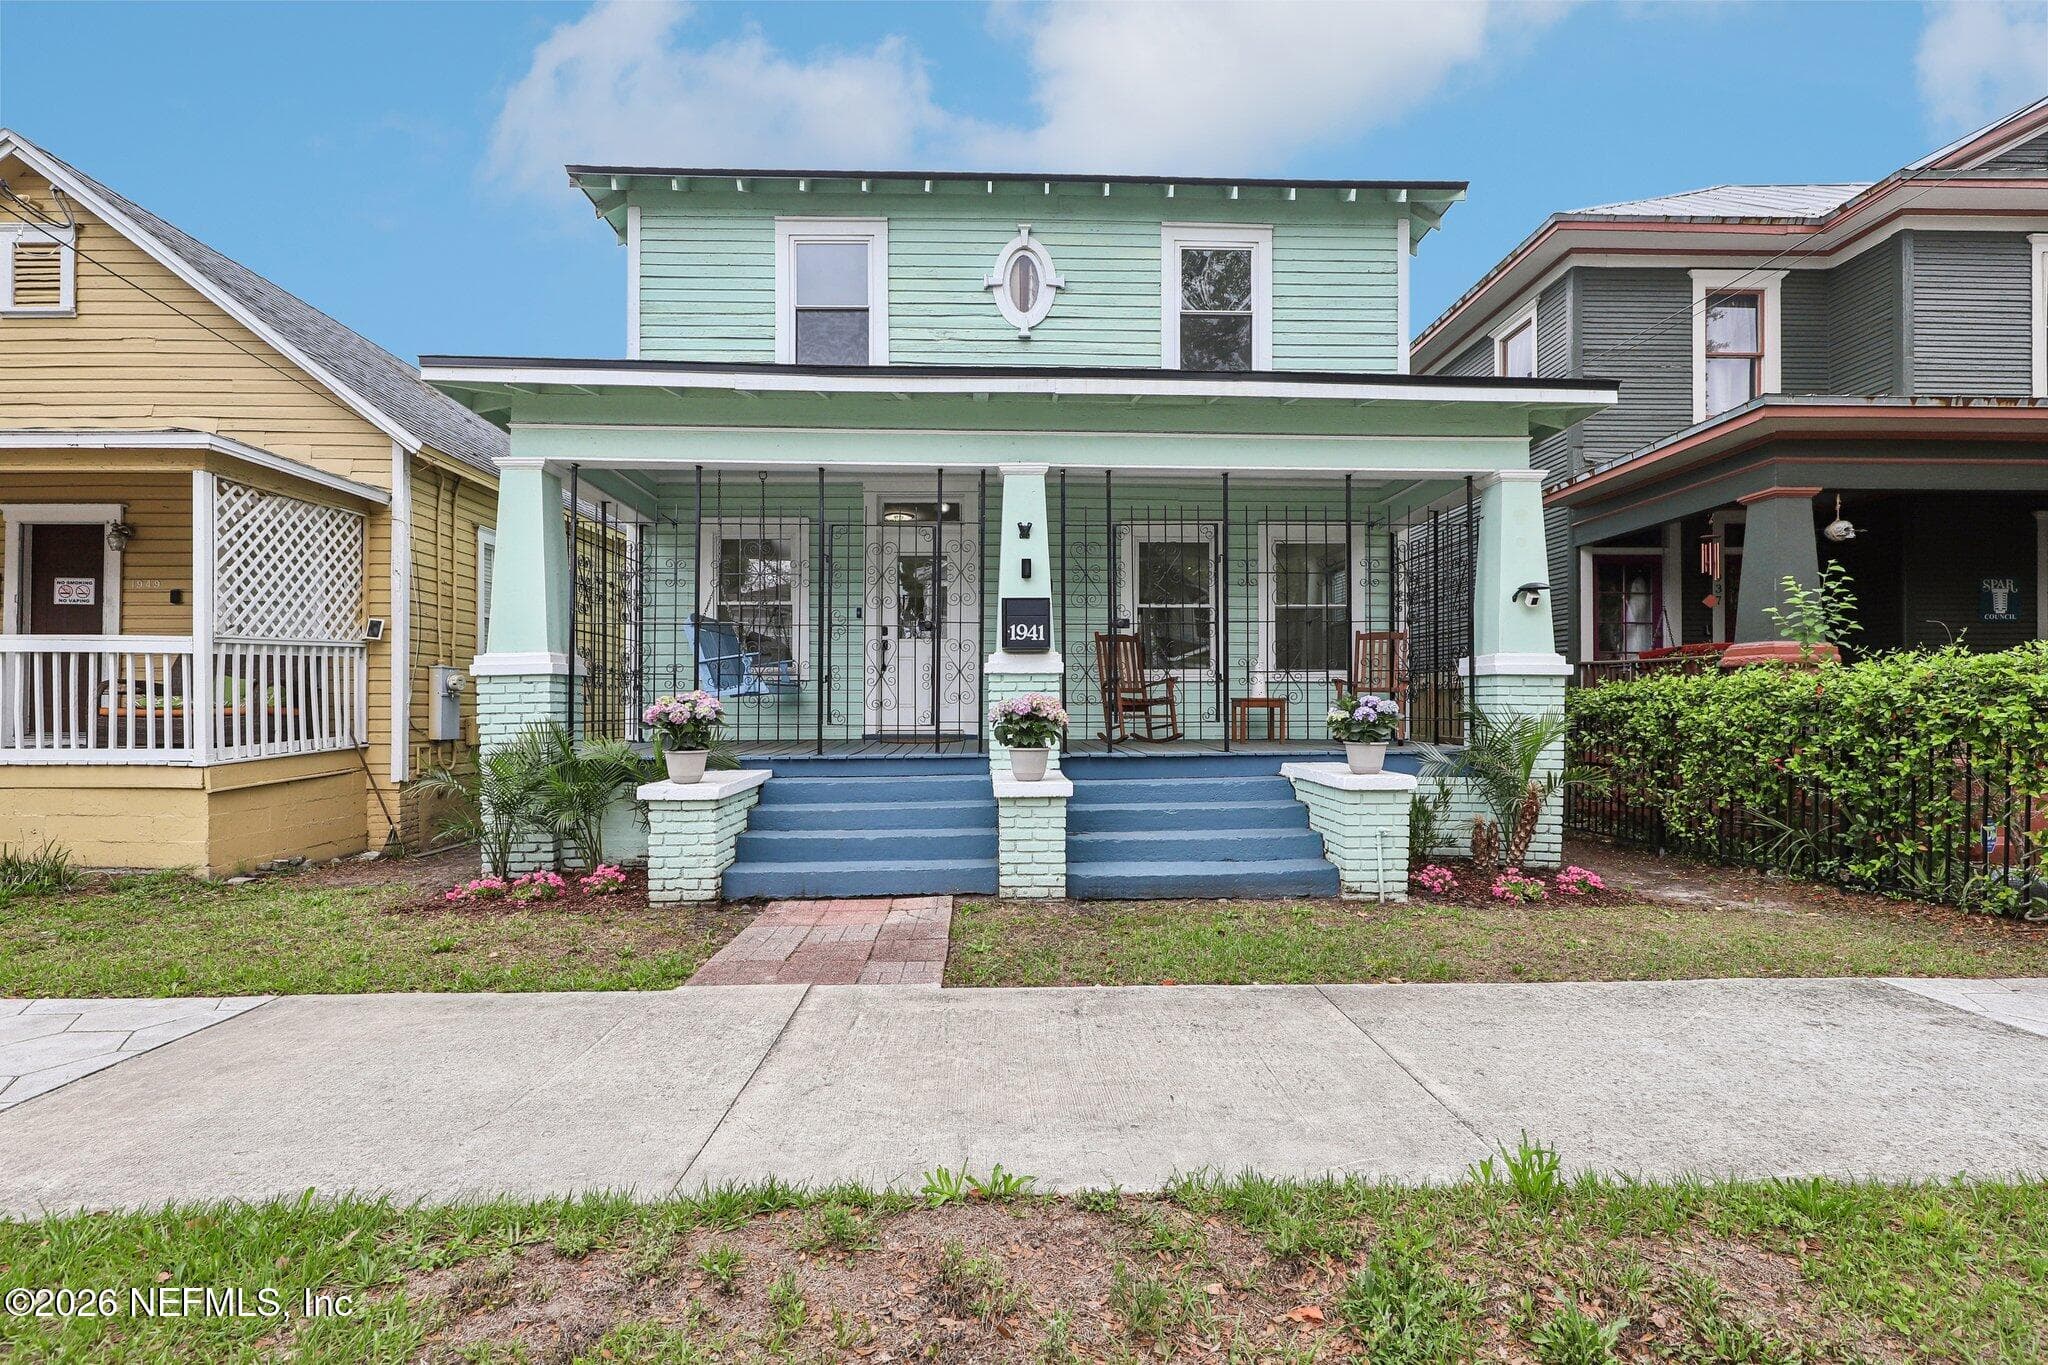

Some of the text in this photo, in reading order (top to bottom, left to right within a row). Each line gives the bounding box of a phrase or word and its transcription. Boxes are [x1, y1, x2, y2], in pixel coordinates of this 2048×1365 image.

[131, 579, 160, 589] 1949
[1982, 579, 2018, 593] SPAR
[1009, 623, 1045, 641] 1941
